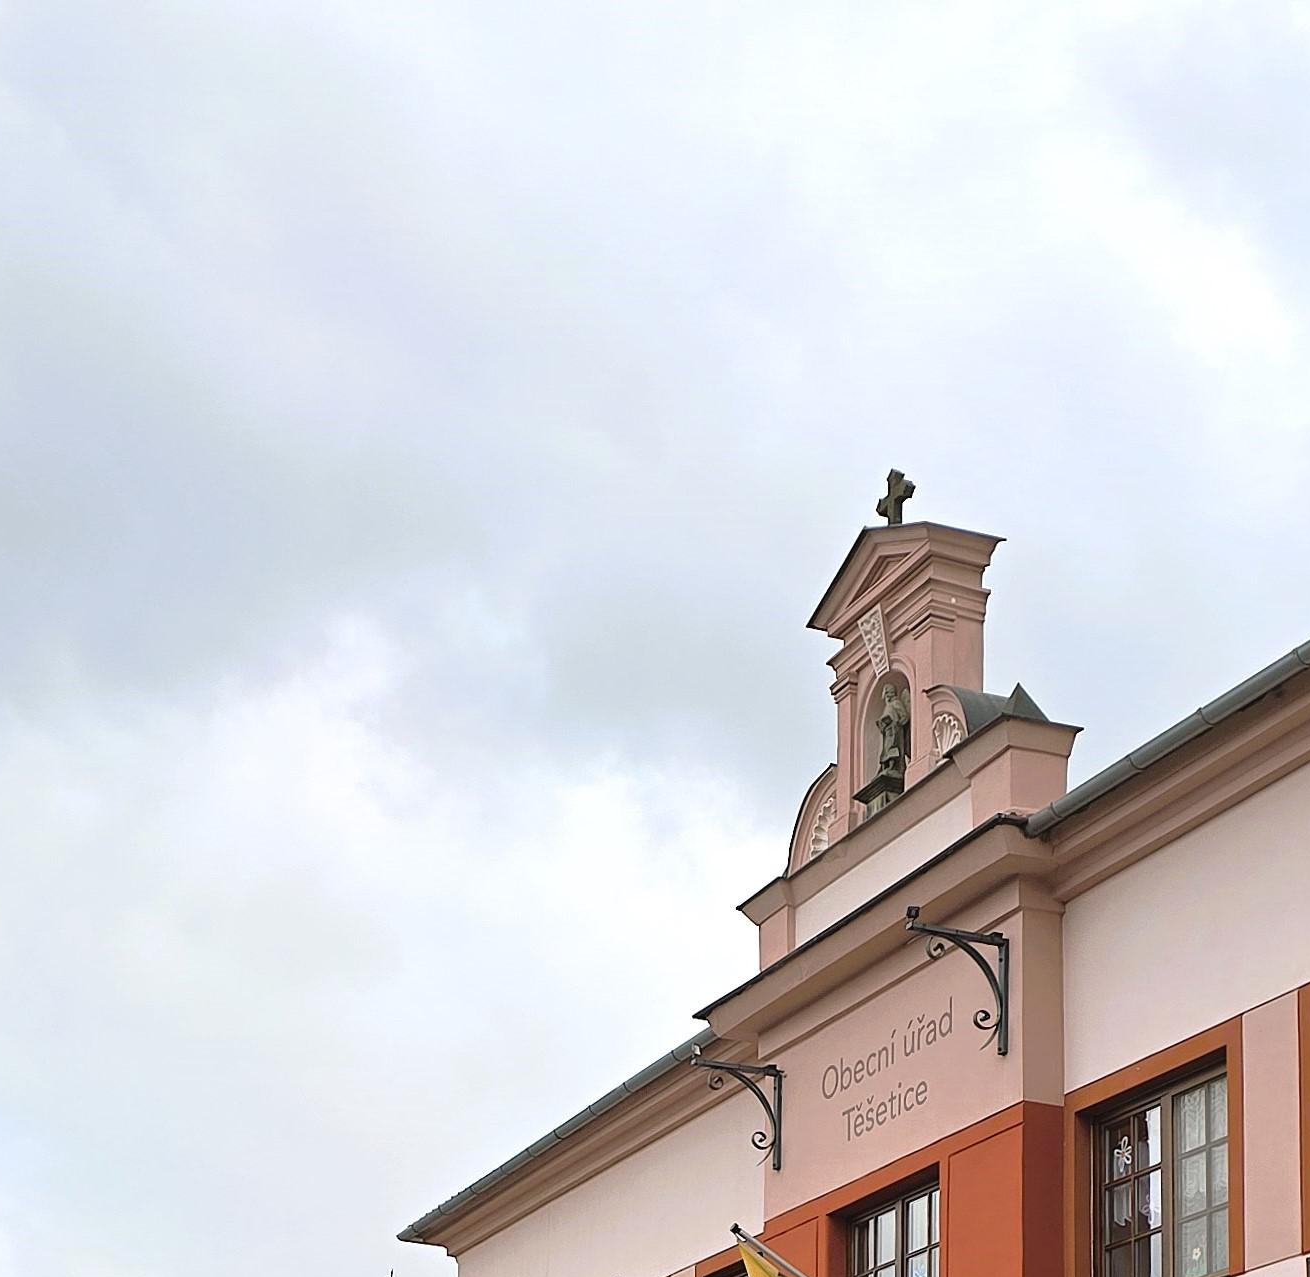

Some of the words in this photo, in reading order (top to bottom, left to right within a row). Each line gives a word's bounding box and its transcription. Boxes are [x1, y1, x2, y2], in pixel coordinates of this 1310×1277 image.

[822, 1029, 897, 1099] Obecní
[903, 996, 954, 1057] úřad
[842, 1080, 929, 1142] Těšetice
